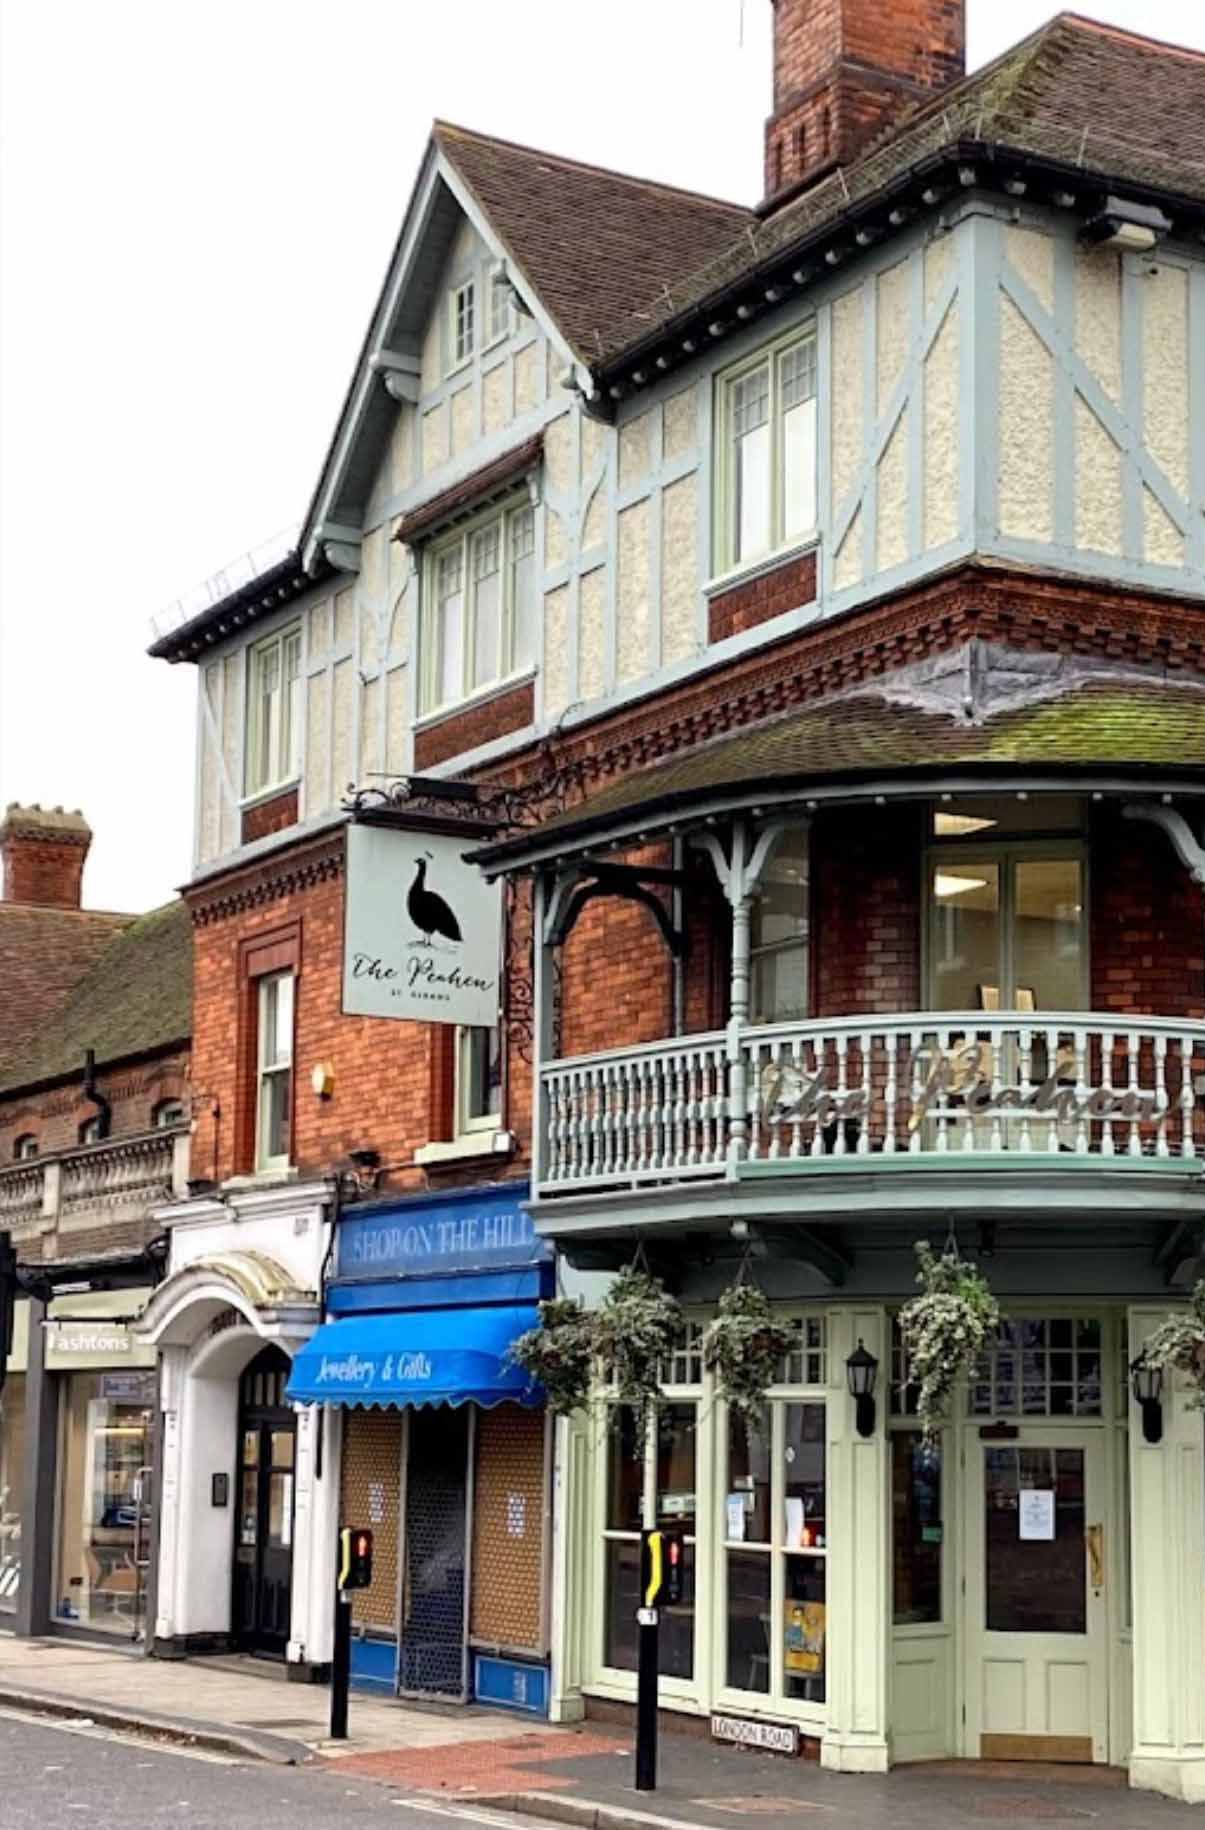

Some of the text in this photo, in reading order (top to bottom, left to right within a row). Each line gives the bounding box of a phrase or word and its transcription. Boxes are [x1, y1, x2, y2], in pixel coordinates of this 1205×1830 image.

[352, 952, 495, 991] The Peahen
[353, 1212, 534, 1263] SHOP ON THE HILL
[315, 1354, 377, 1390] Jewellery
[381, 1354, 395, 1382] &
[714, 1719, 792, 1748] LONDON ROAD
